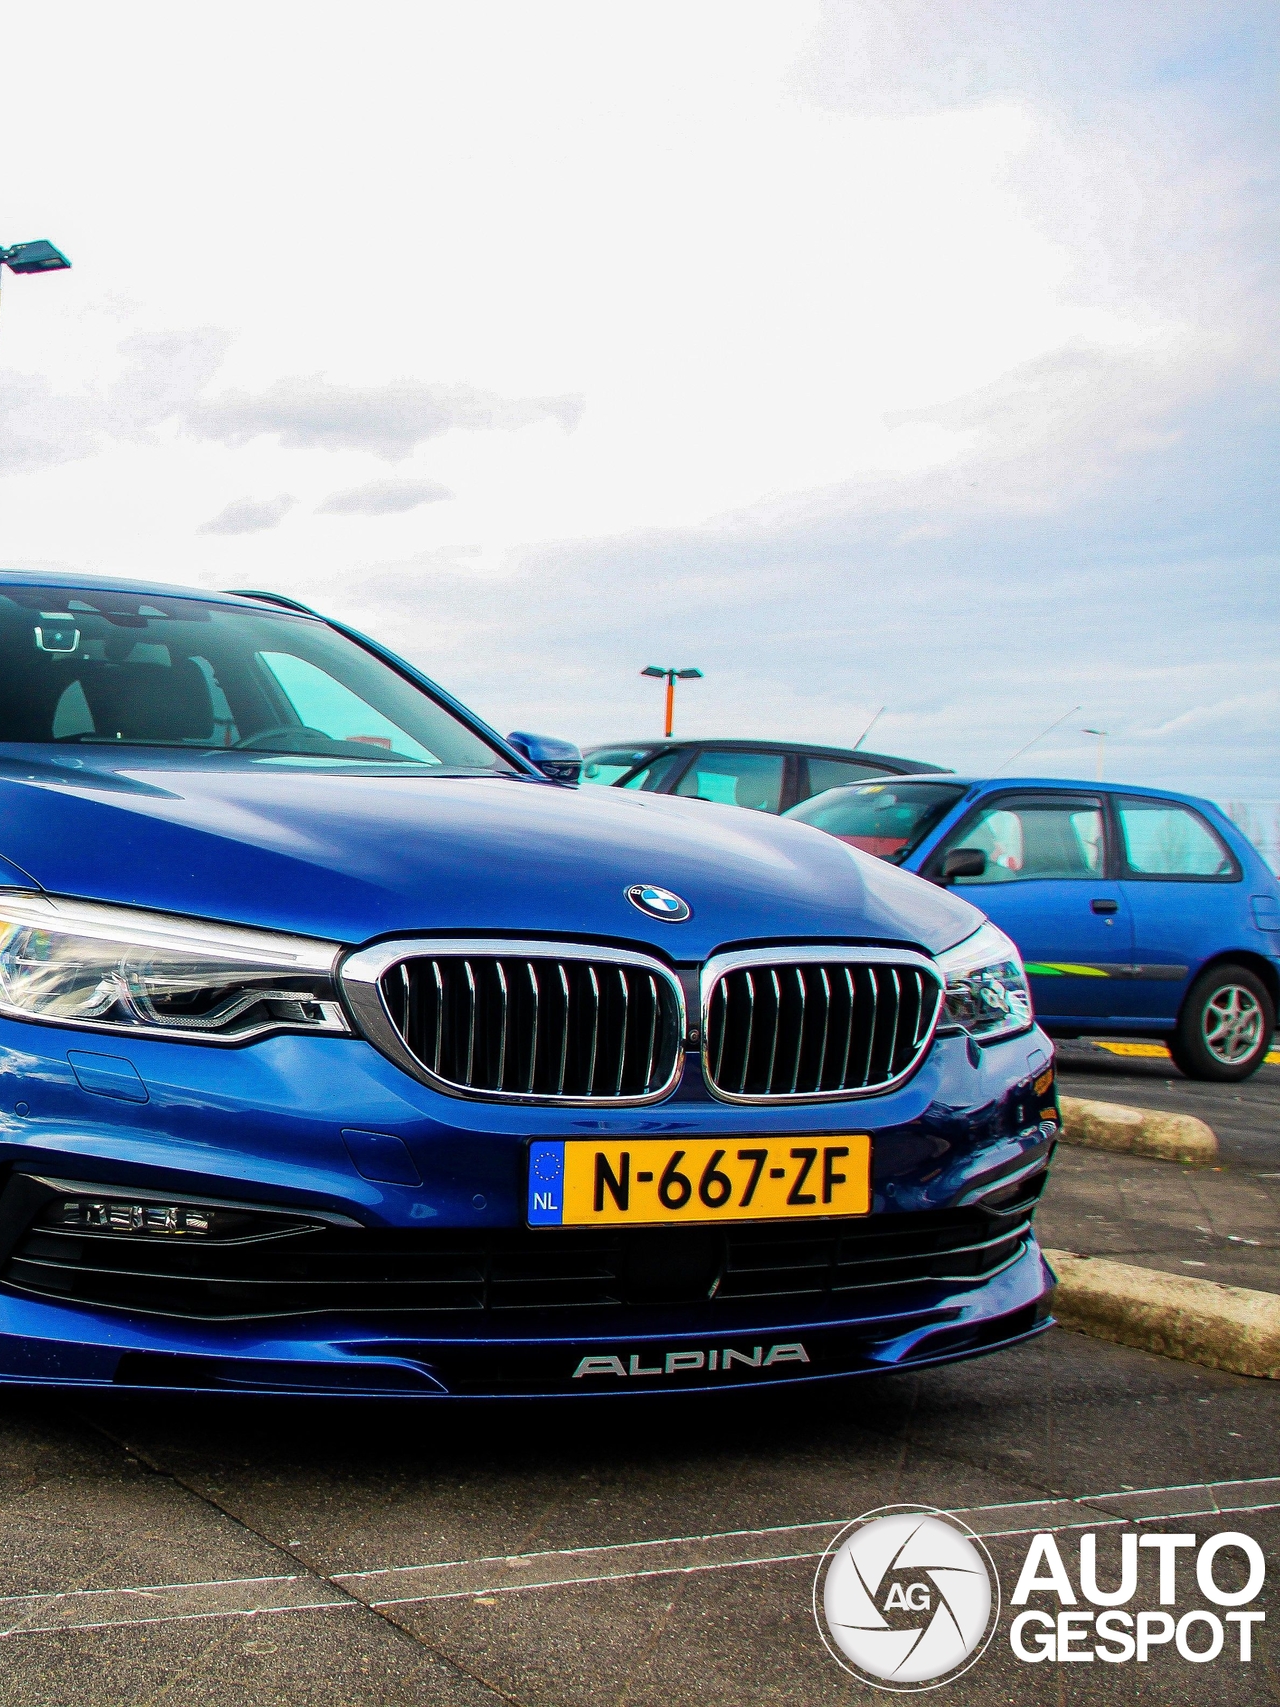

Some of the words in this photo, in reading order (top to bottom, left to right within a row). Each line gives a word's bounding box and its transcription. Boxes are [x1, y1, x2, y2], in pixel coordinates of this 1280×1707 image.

[593, 1147, 849, 1212] N-667-ZF
[533, 1192, 558, 1210] NL
[572, 1343, 810, 1378] ALPINA
